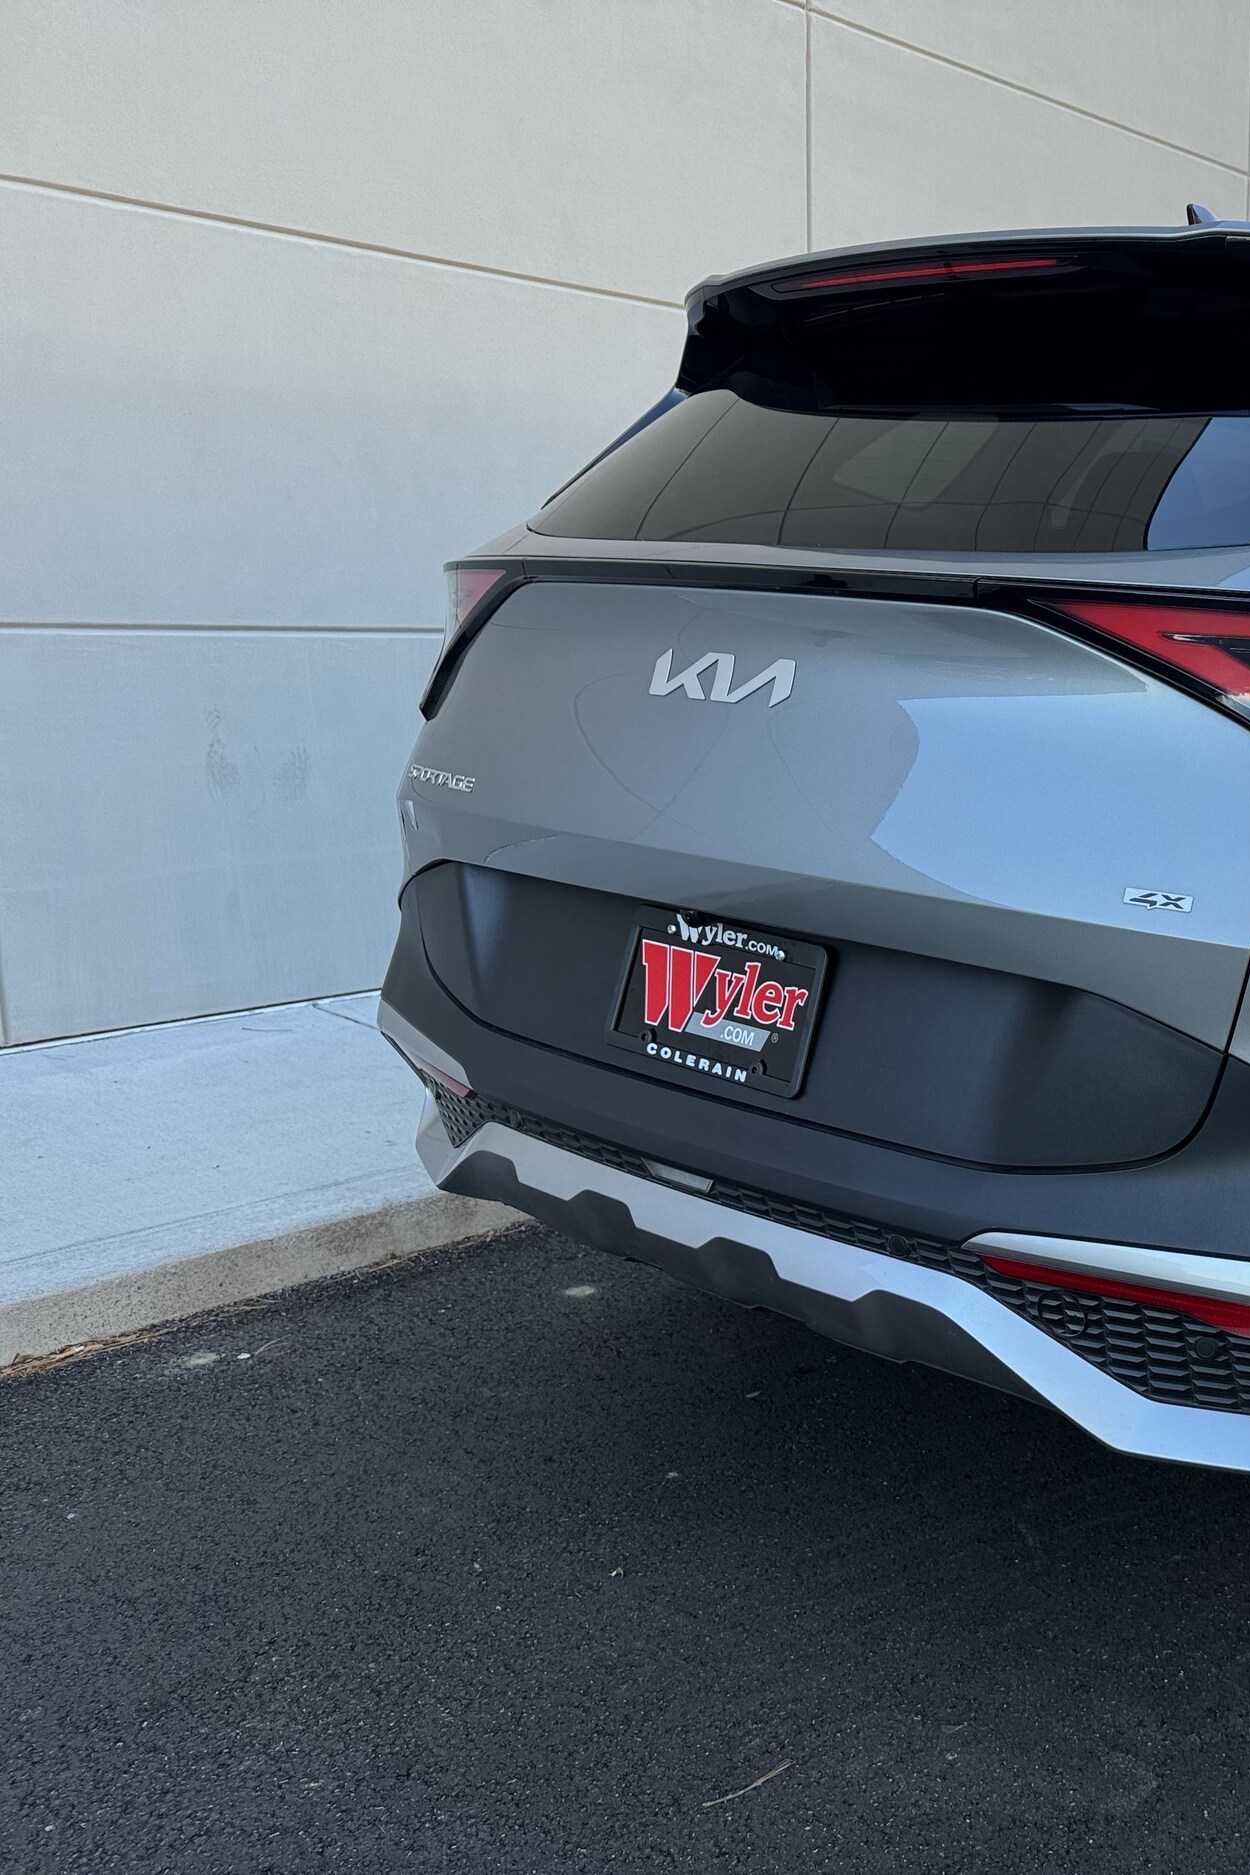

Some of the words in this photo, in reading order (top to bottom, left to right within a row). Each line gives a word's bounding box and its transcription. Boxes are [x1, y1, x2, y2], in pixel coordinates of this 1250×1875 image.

[649, 647, 797, 708] KIA
[408, 763, 477, 792] SPORTAGE
[642, 938, 808, 1032] Wyler
[646, 1042, 747, 1082] COLERAIN
